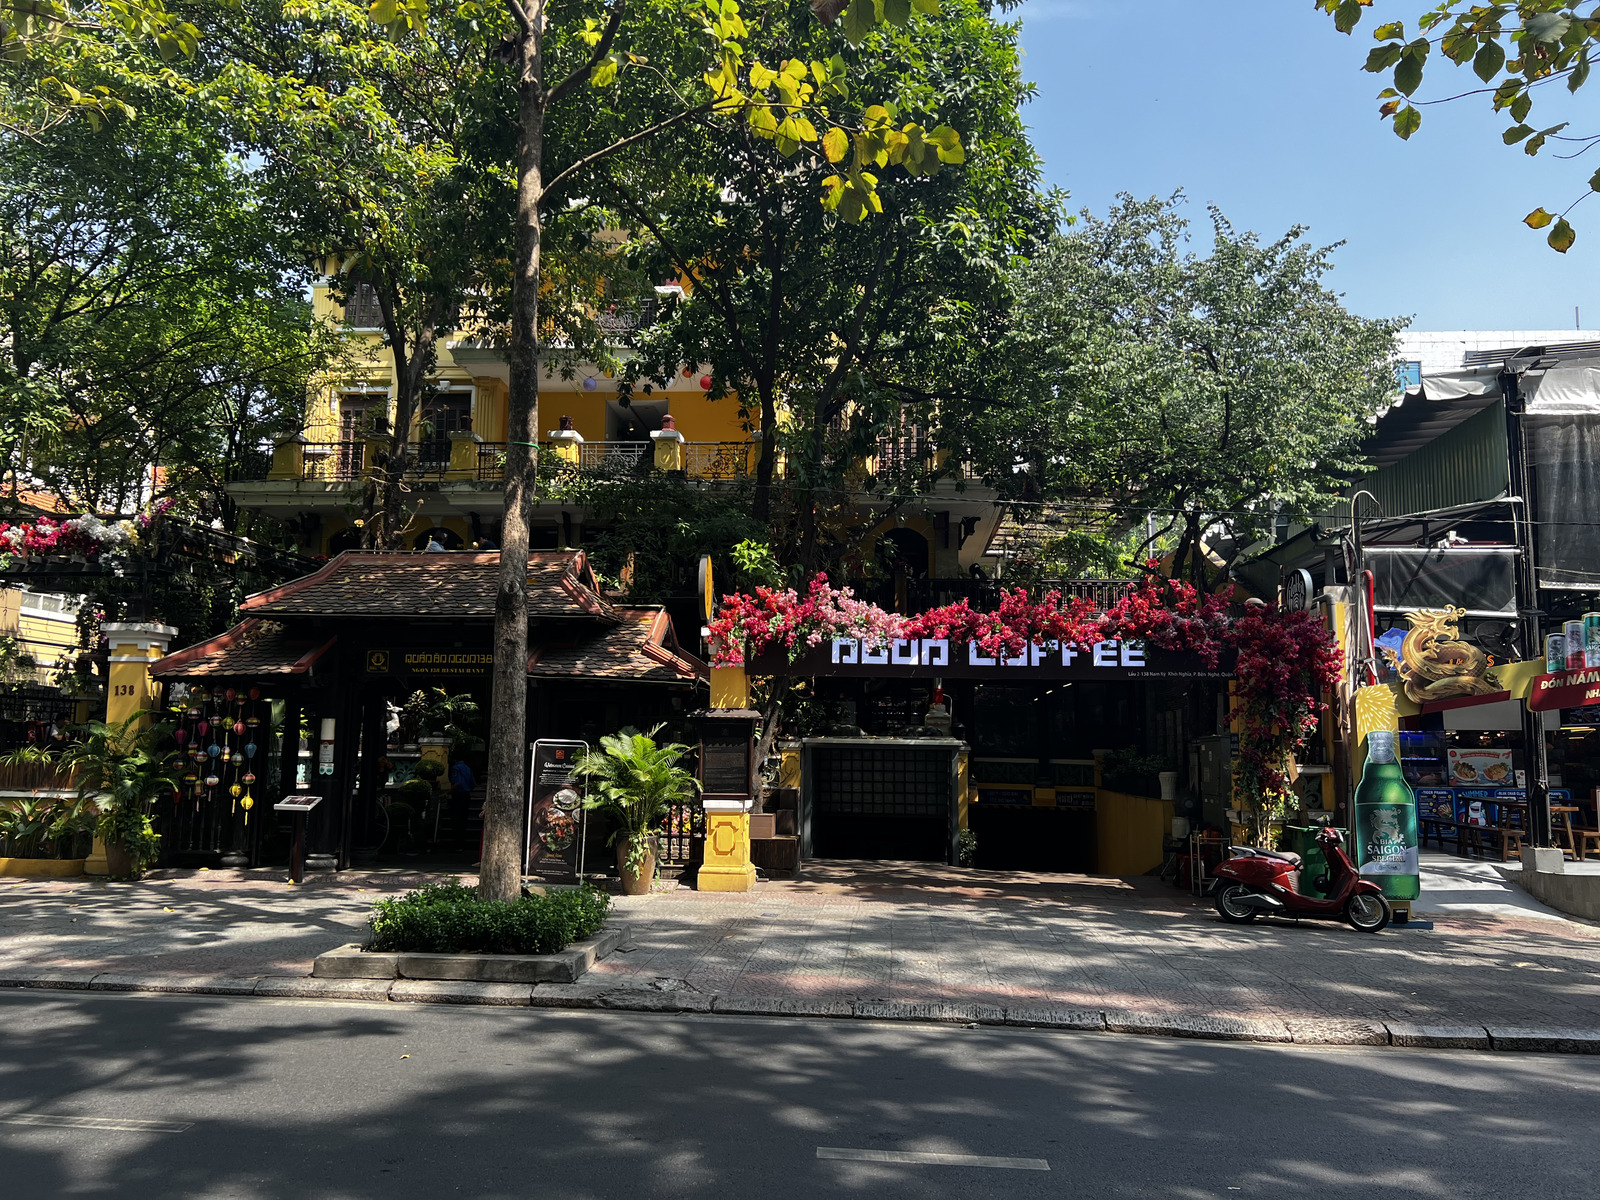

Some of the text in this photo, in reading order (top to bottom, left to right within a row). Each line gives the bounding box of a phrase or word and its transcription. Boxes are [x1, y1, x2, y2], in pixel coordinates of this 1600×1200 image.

[1540, 670, 1600, 690] ĐÓN NĂM
[114, 684, 135, 696] 138
[1585, 688, 1600, 699] NH
[1367, 845, 1407, 854] SAIGON
